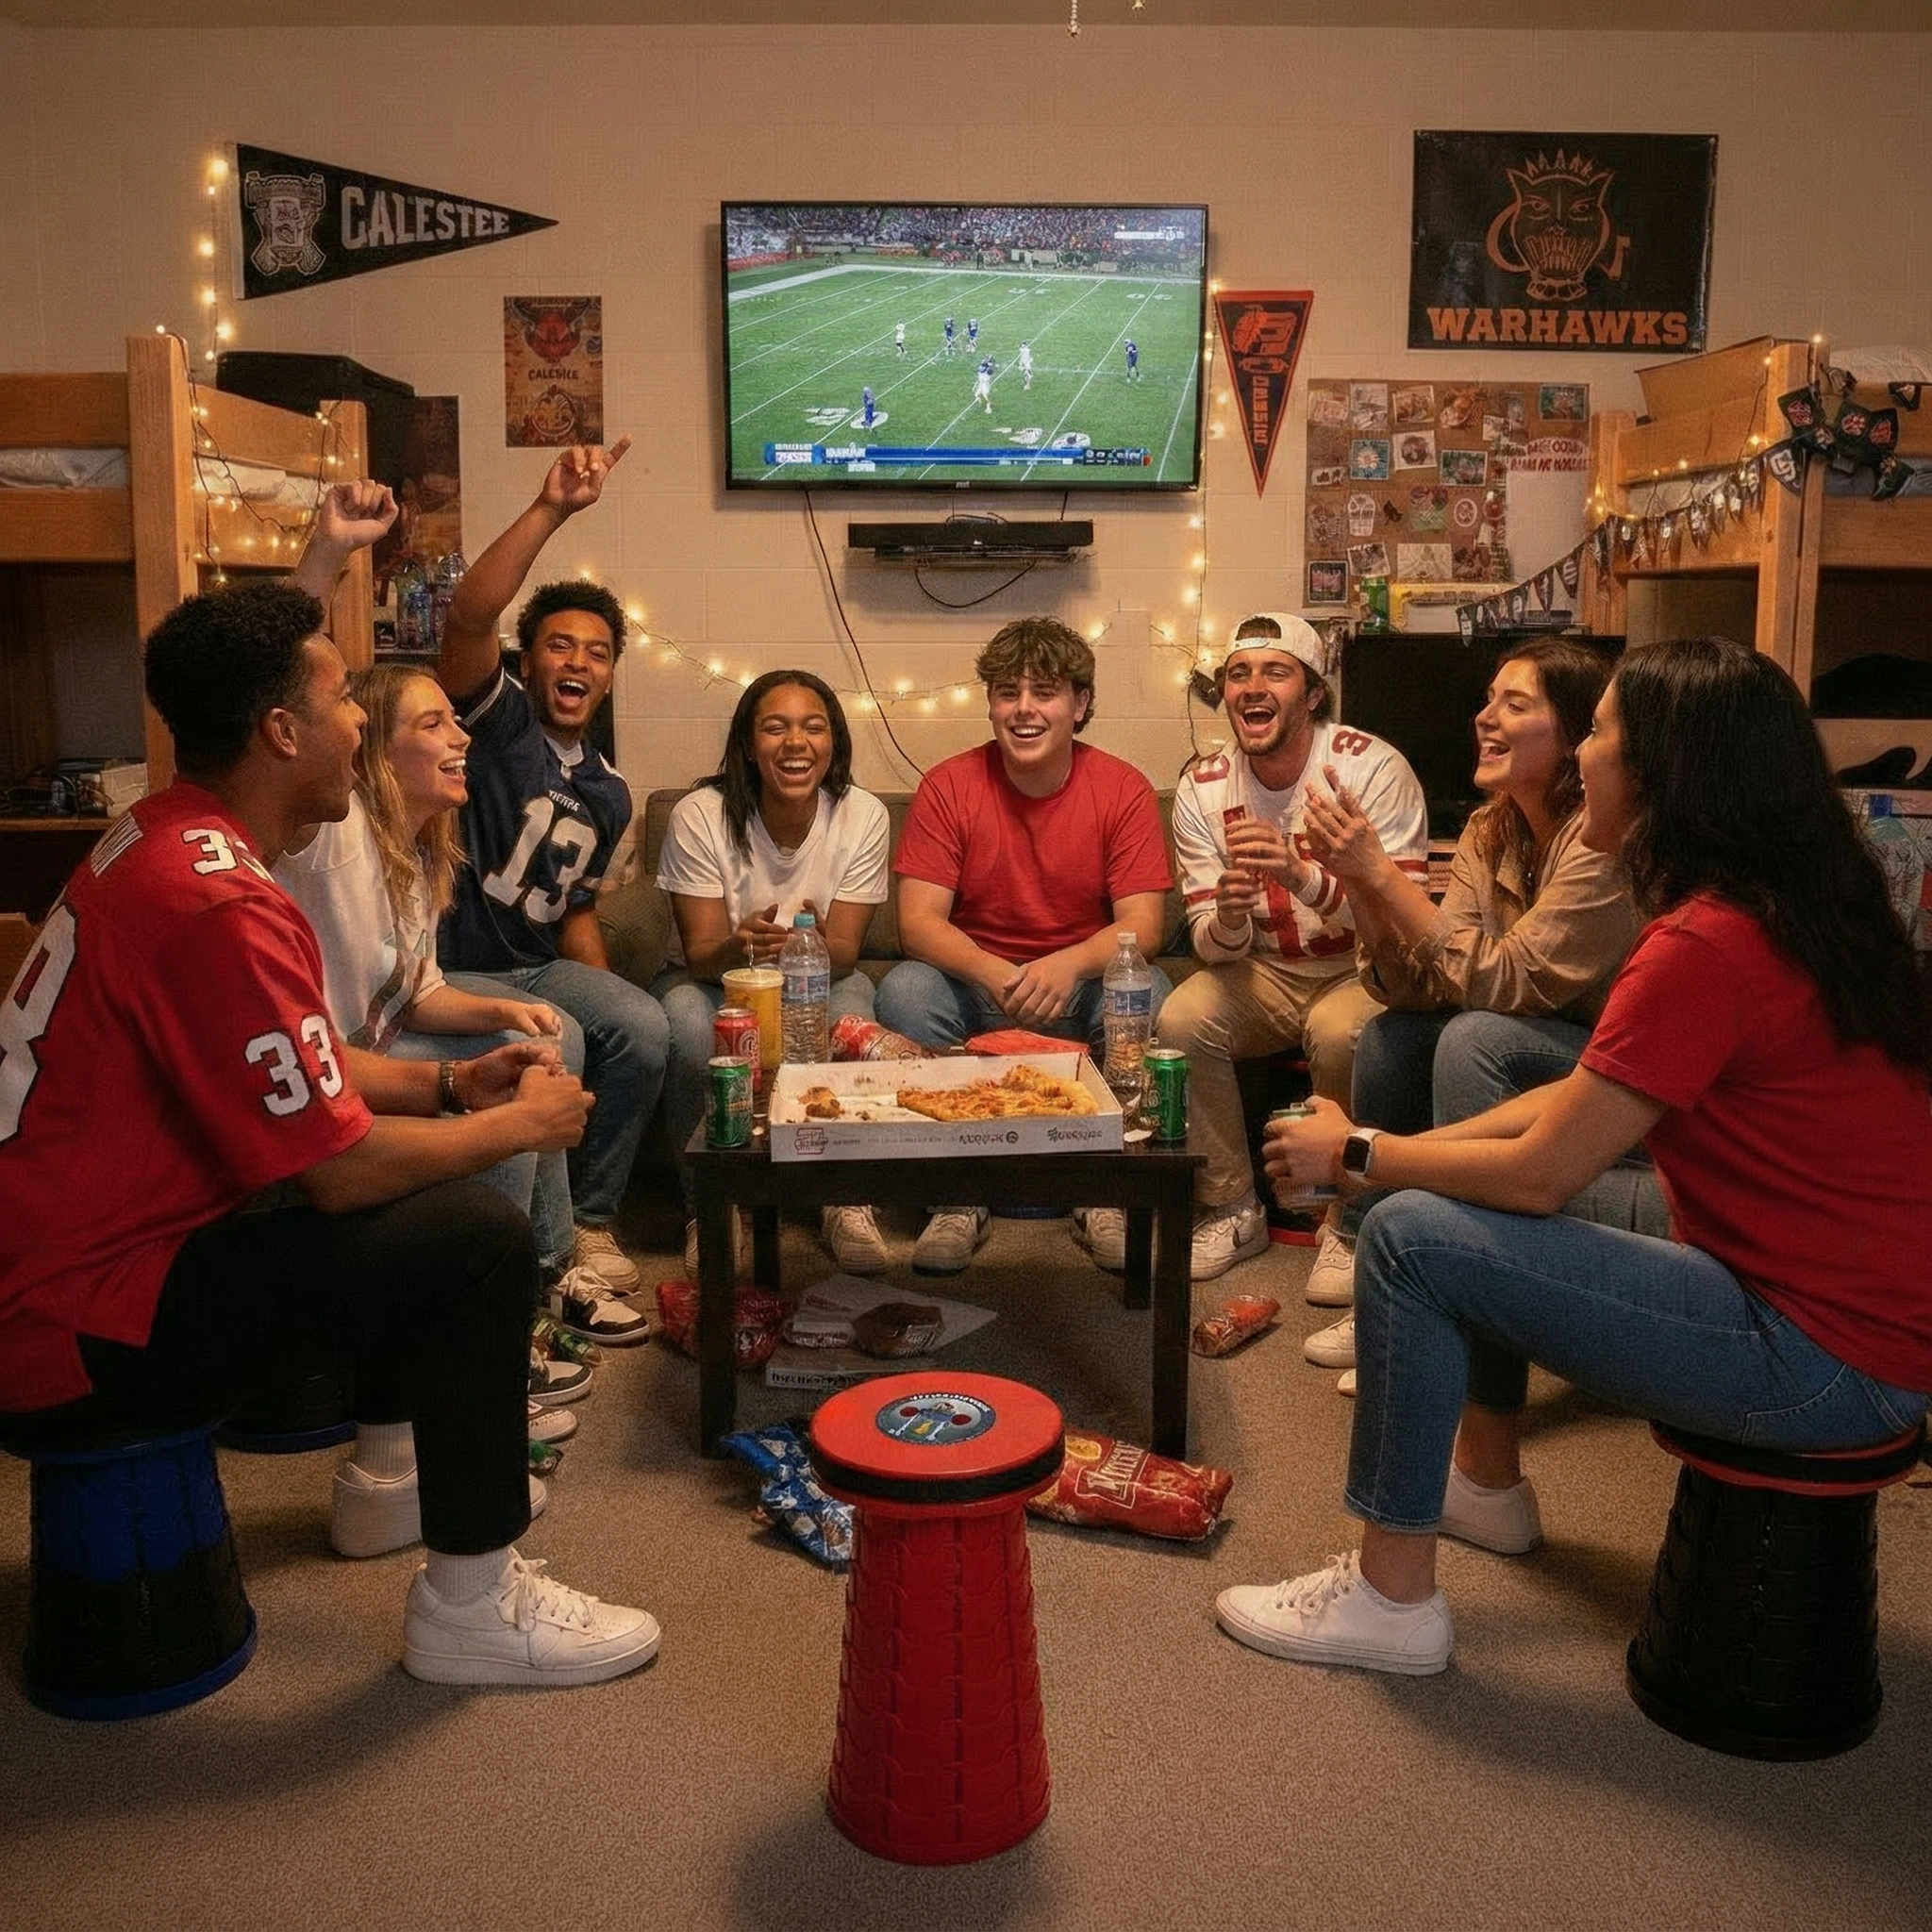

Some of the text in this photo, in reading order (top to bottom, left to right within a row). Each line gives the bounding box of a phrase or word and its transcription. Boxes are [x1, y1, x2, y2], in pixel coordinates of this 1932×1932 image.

[341, 185, 510, 250] CALESTEE
[1426, 307, 1688, 345] WARHAWKS
[482, 797, 597, 924] 13
[244, 1014, 343, 1116] 33
